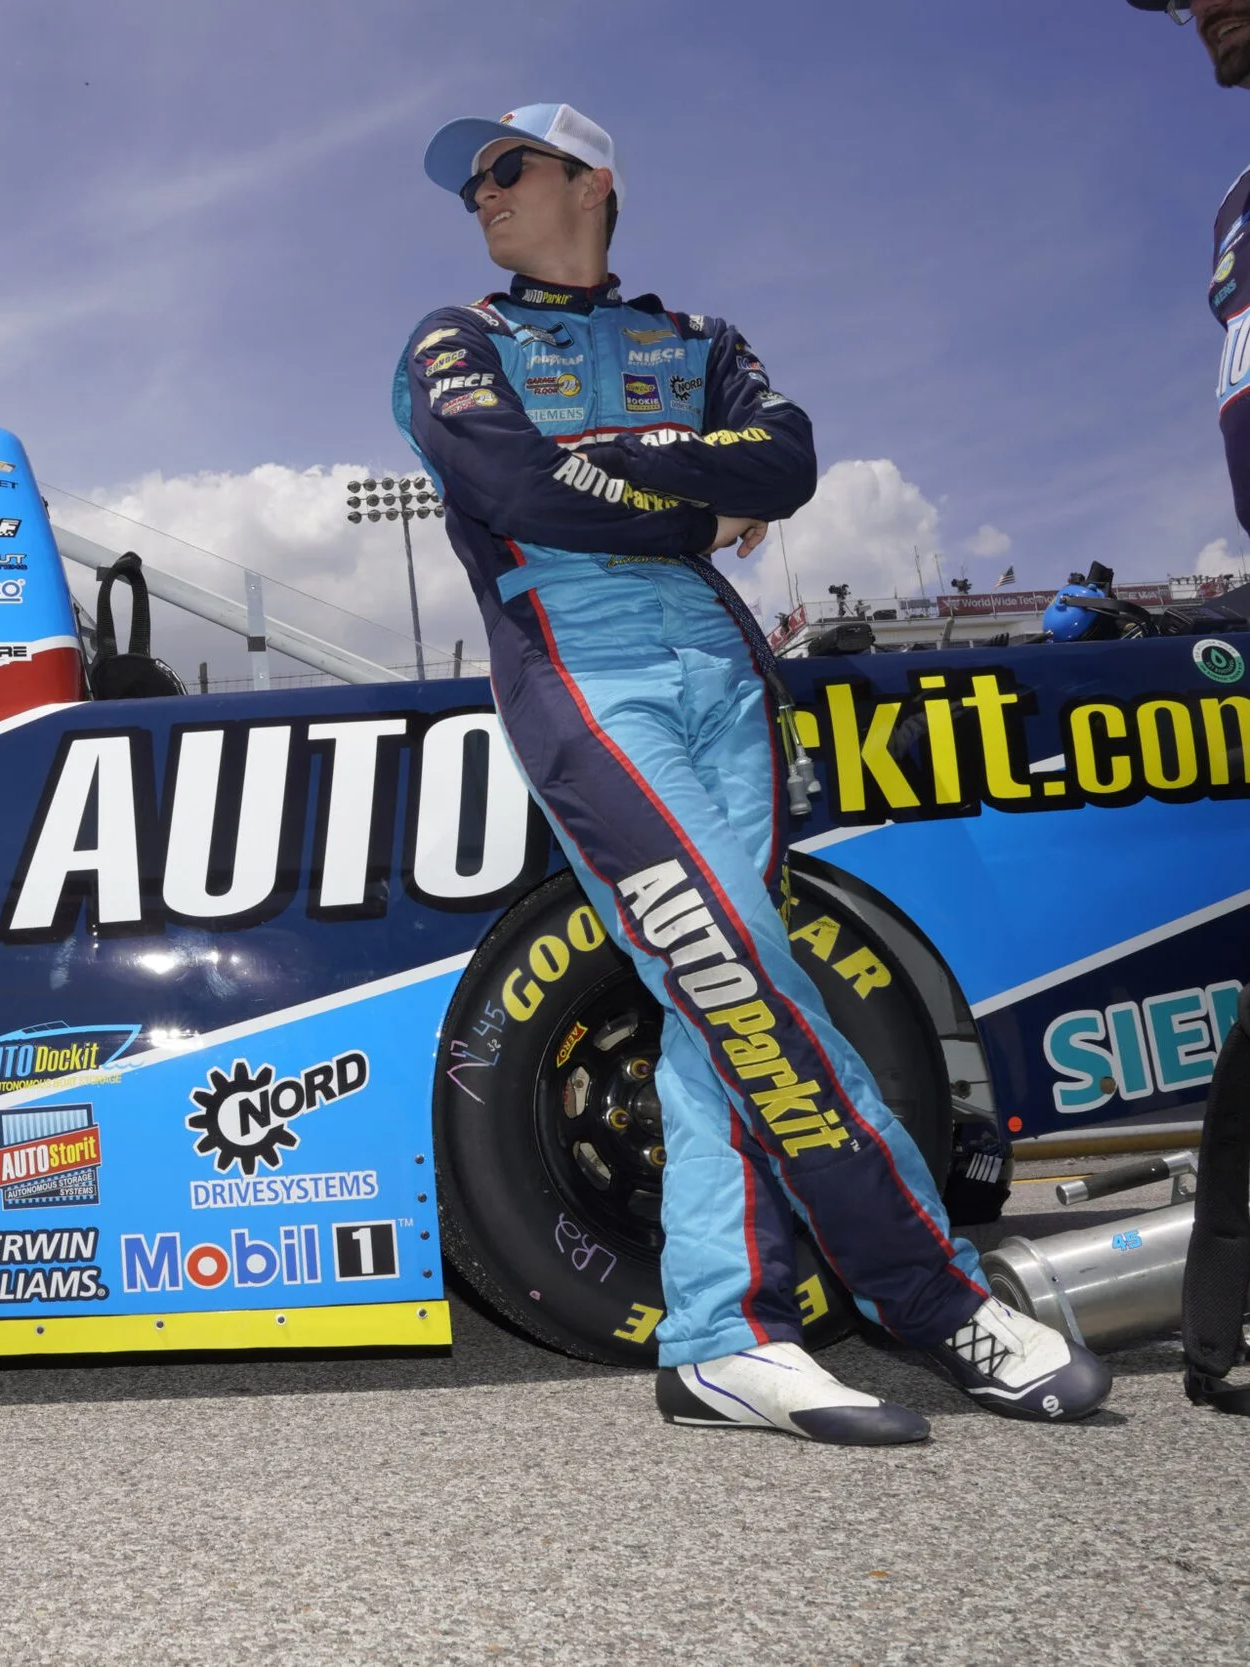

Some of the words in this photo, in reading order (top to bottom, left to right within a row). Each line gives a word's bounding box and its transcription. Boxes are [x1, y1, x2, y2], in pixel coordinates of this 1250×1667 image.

[426, 349, 466, 377] SUNOCO
[629, 348, 685, 363] NIECE
[678, 378, 703, 393] NORD
[528, 409, 583, 421] SIEMENS
[472, 1000, 506, 1037] 45
[617, 858, 850, 1158] AUTOParkit
[559, 1025, 579, 1059] AERO
[79, 1073, 122, 1086] STORAGE
[239, 1052, 368, 1137] NORD
[1, 1136, 98, 1182] AUTOStorit
[7, 1180, 58, 1199] AUTONOMOUS
[59, 1172, 94, 1188] STORAGE
[59, 1186, 94, 1197] SYSTEMS
[192, 1174, 377, 1208] DRIVESYSTEMS
[1112, 1228, 1142, 1252] 45
[123, 1225, 319, 1292] Mobil
